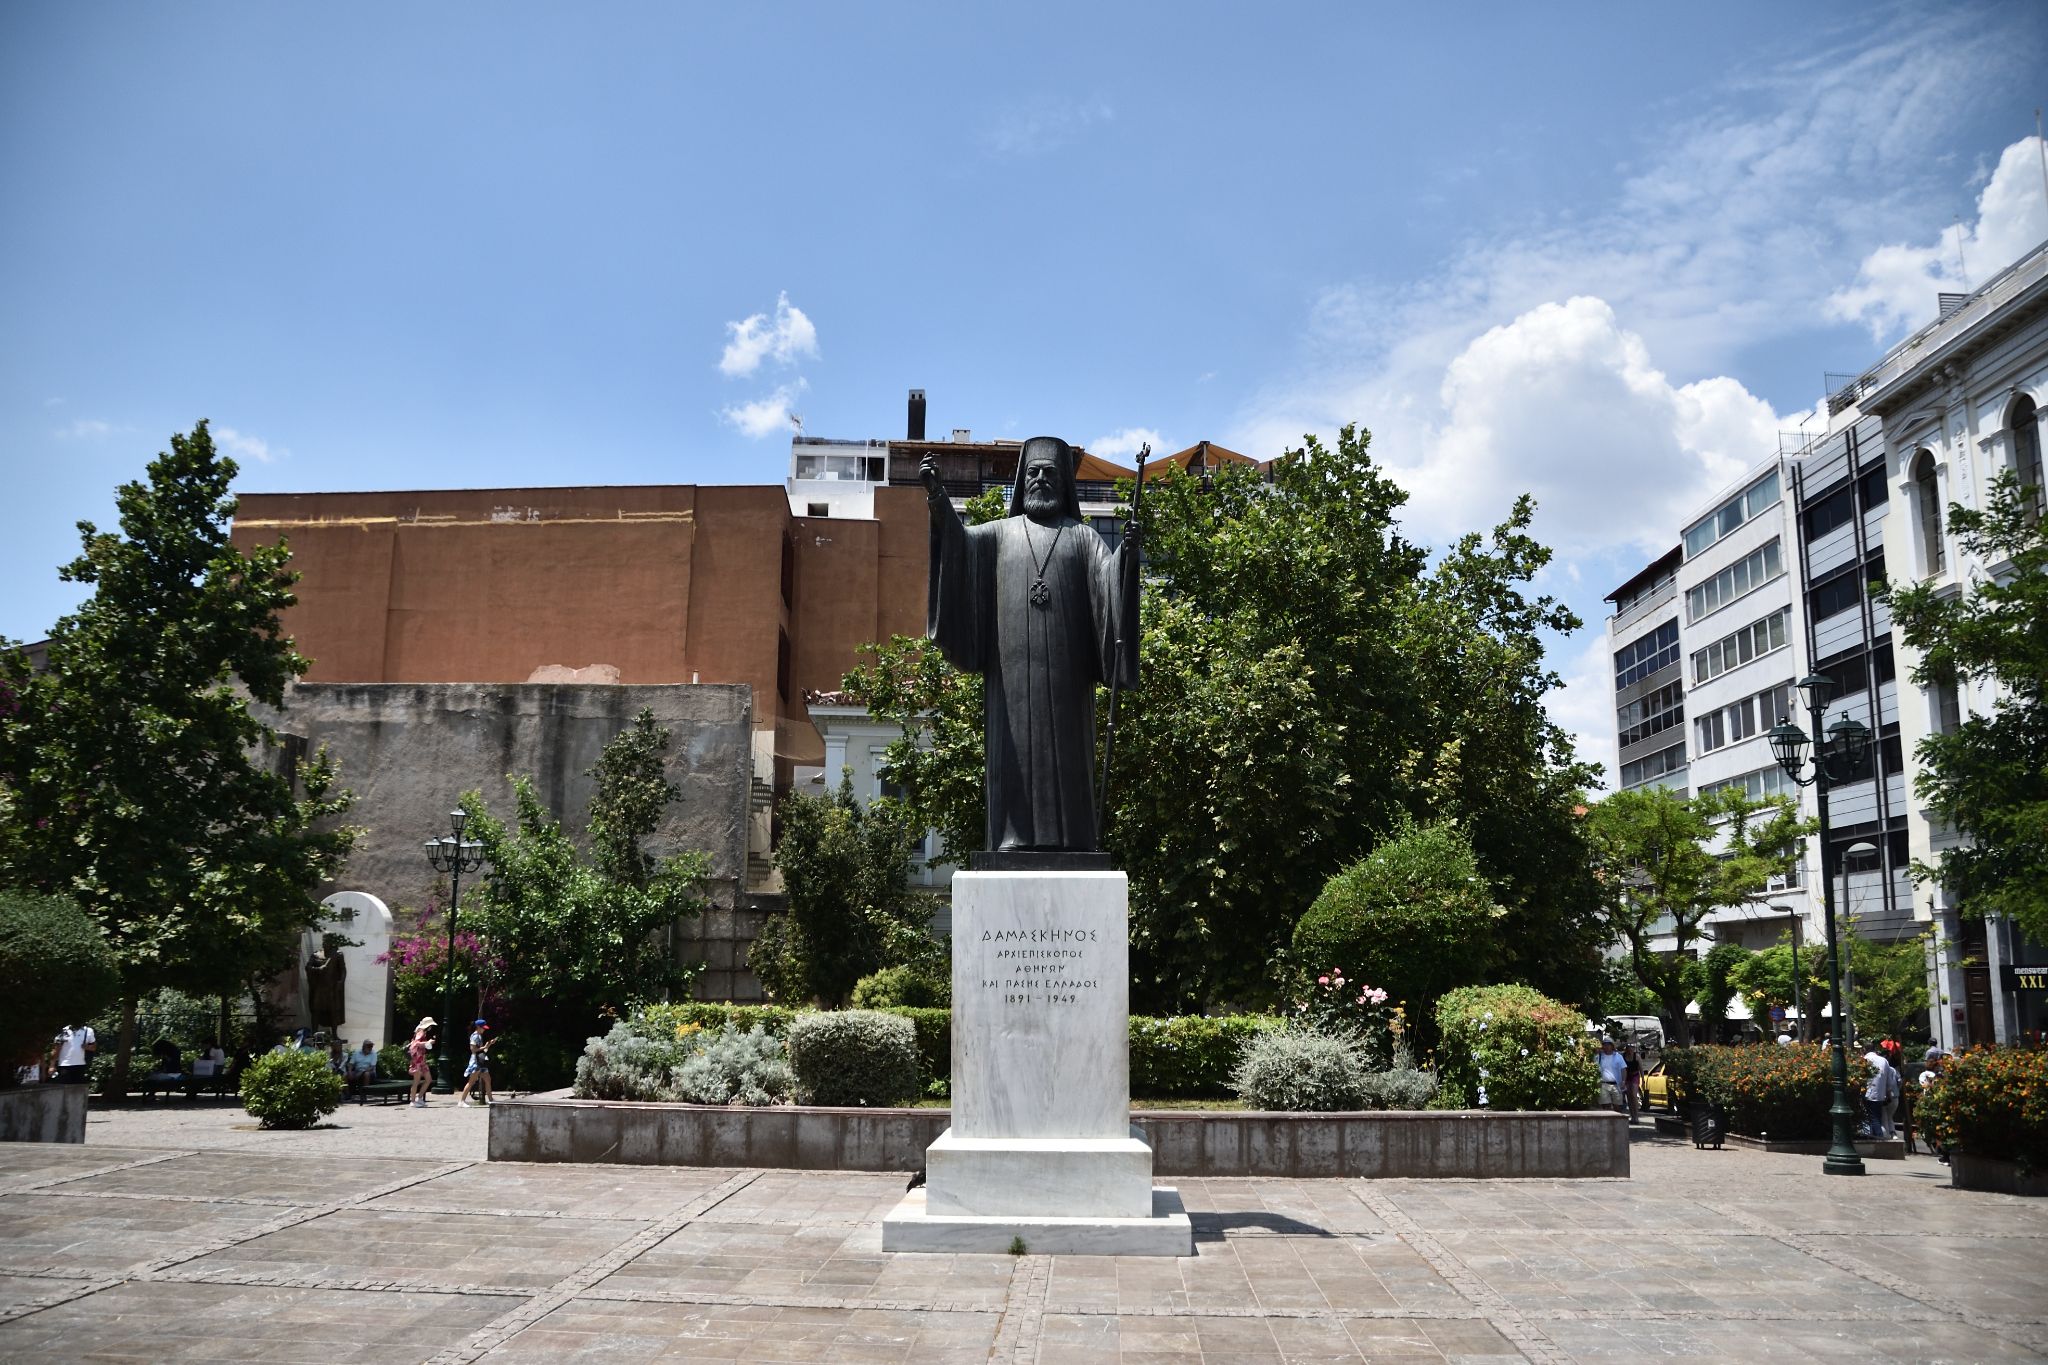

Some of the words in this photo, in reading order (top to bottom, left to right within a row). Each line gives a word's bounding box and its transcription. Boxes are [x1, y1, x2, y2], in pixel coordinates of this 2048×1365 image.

[982, 929, 1097, 942] ΔΑΜΑΣΚΗΝΟΣ
[997, 950, 1083, 959] ΑΡΧΙΕΠΙΣΚΟΠΟΣ
[1015, 965, 1065, 974] ΑΘΗΝΩΝ
[982, 980, 998, 989] ΚΑΙ
[1005, 980, 1039, 989] ΠΑΣΗΣ
[1045, 980, 1098, 989] ΕΛΛΑΔΟΣ
[2019, 975, 2046, 988] XXL
